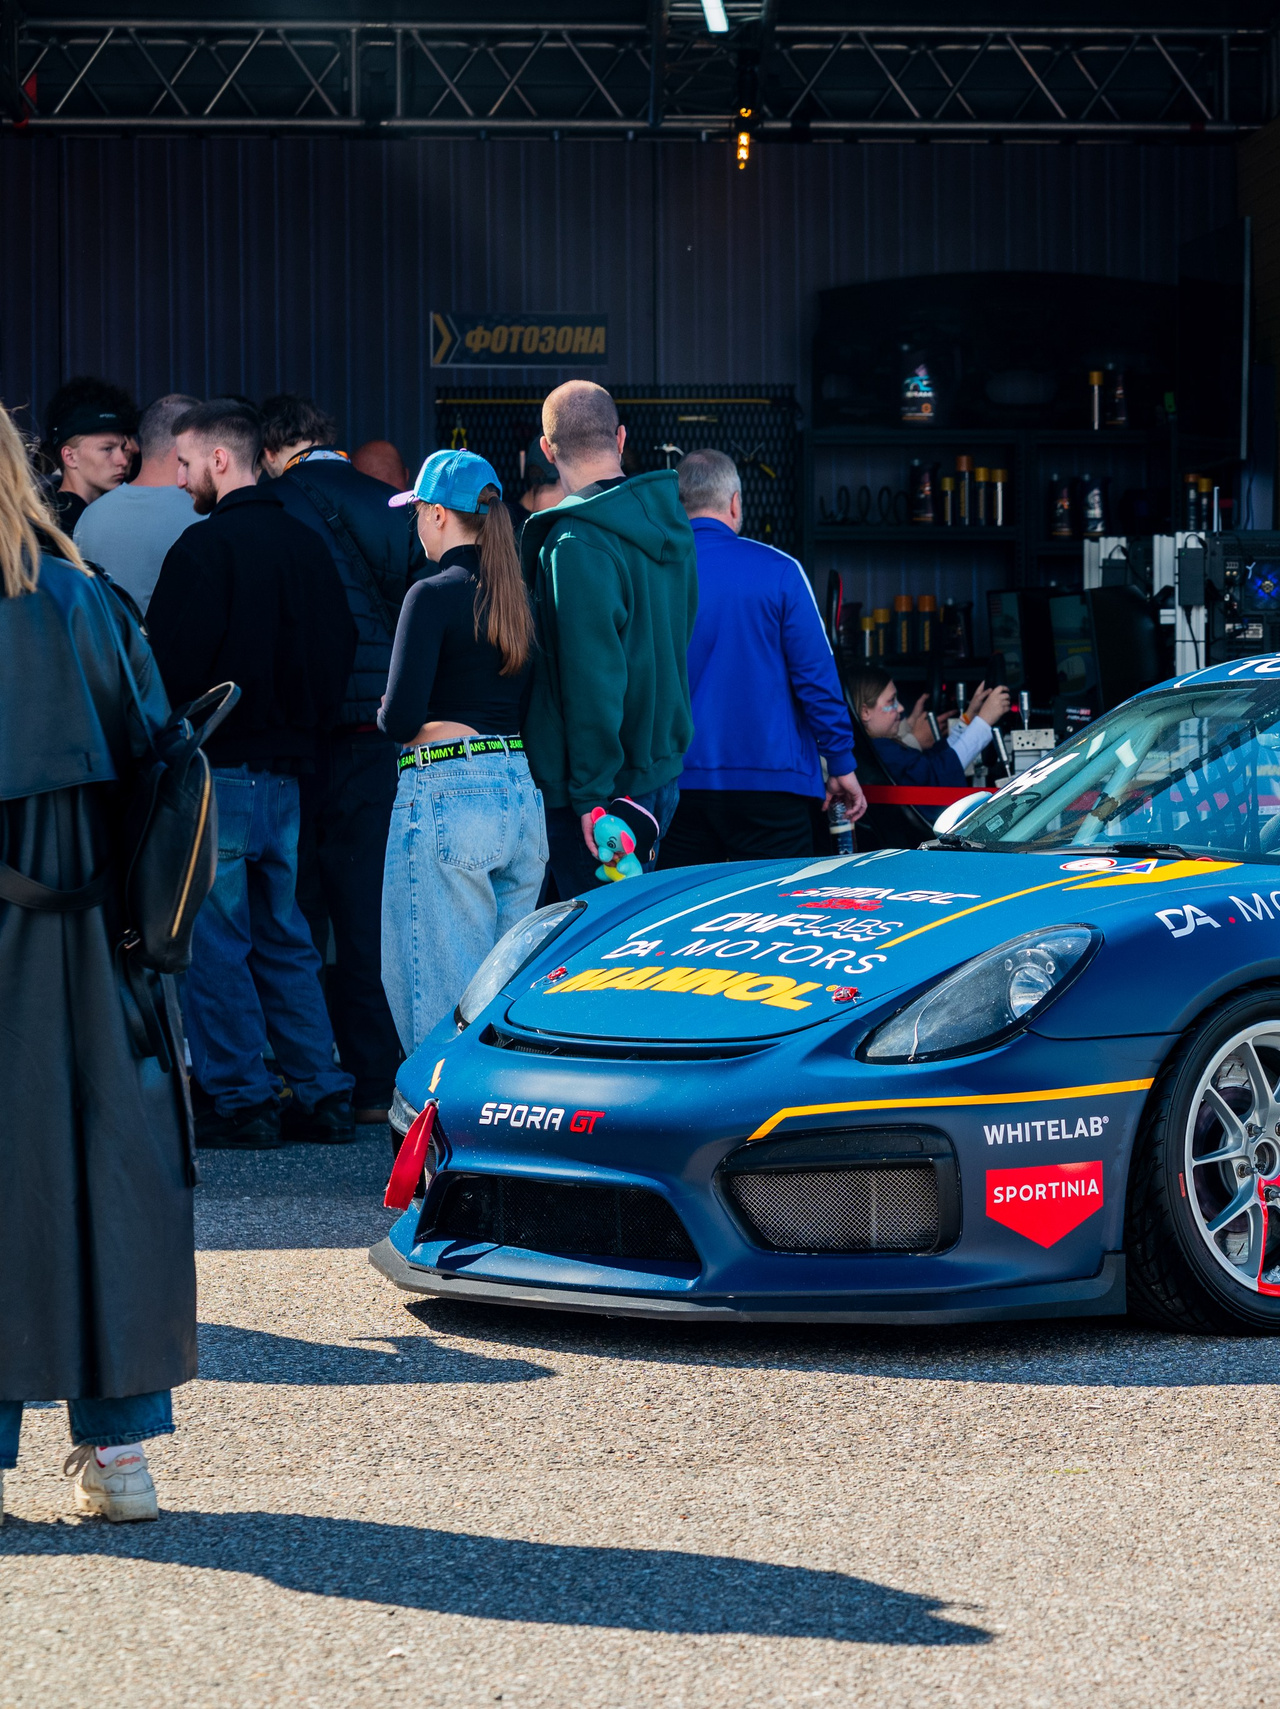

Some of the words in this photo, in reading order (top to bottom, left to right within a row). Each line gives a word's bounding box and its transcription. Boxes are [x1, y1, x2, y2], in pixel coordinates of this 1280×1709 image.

[465, 325, 606, 354] ФОТОЗОНА
[478, 1102, 566, 1131] SPORA
[569, 1109, 606, 1135] GT
[993, 1178, 1100, 1204] SPORTINIA
